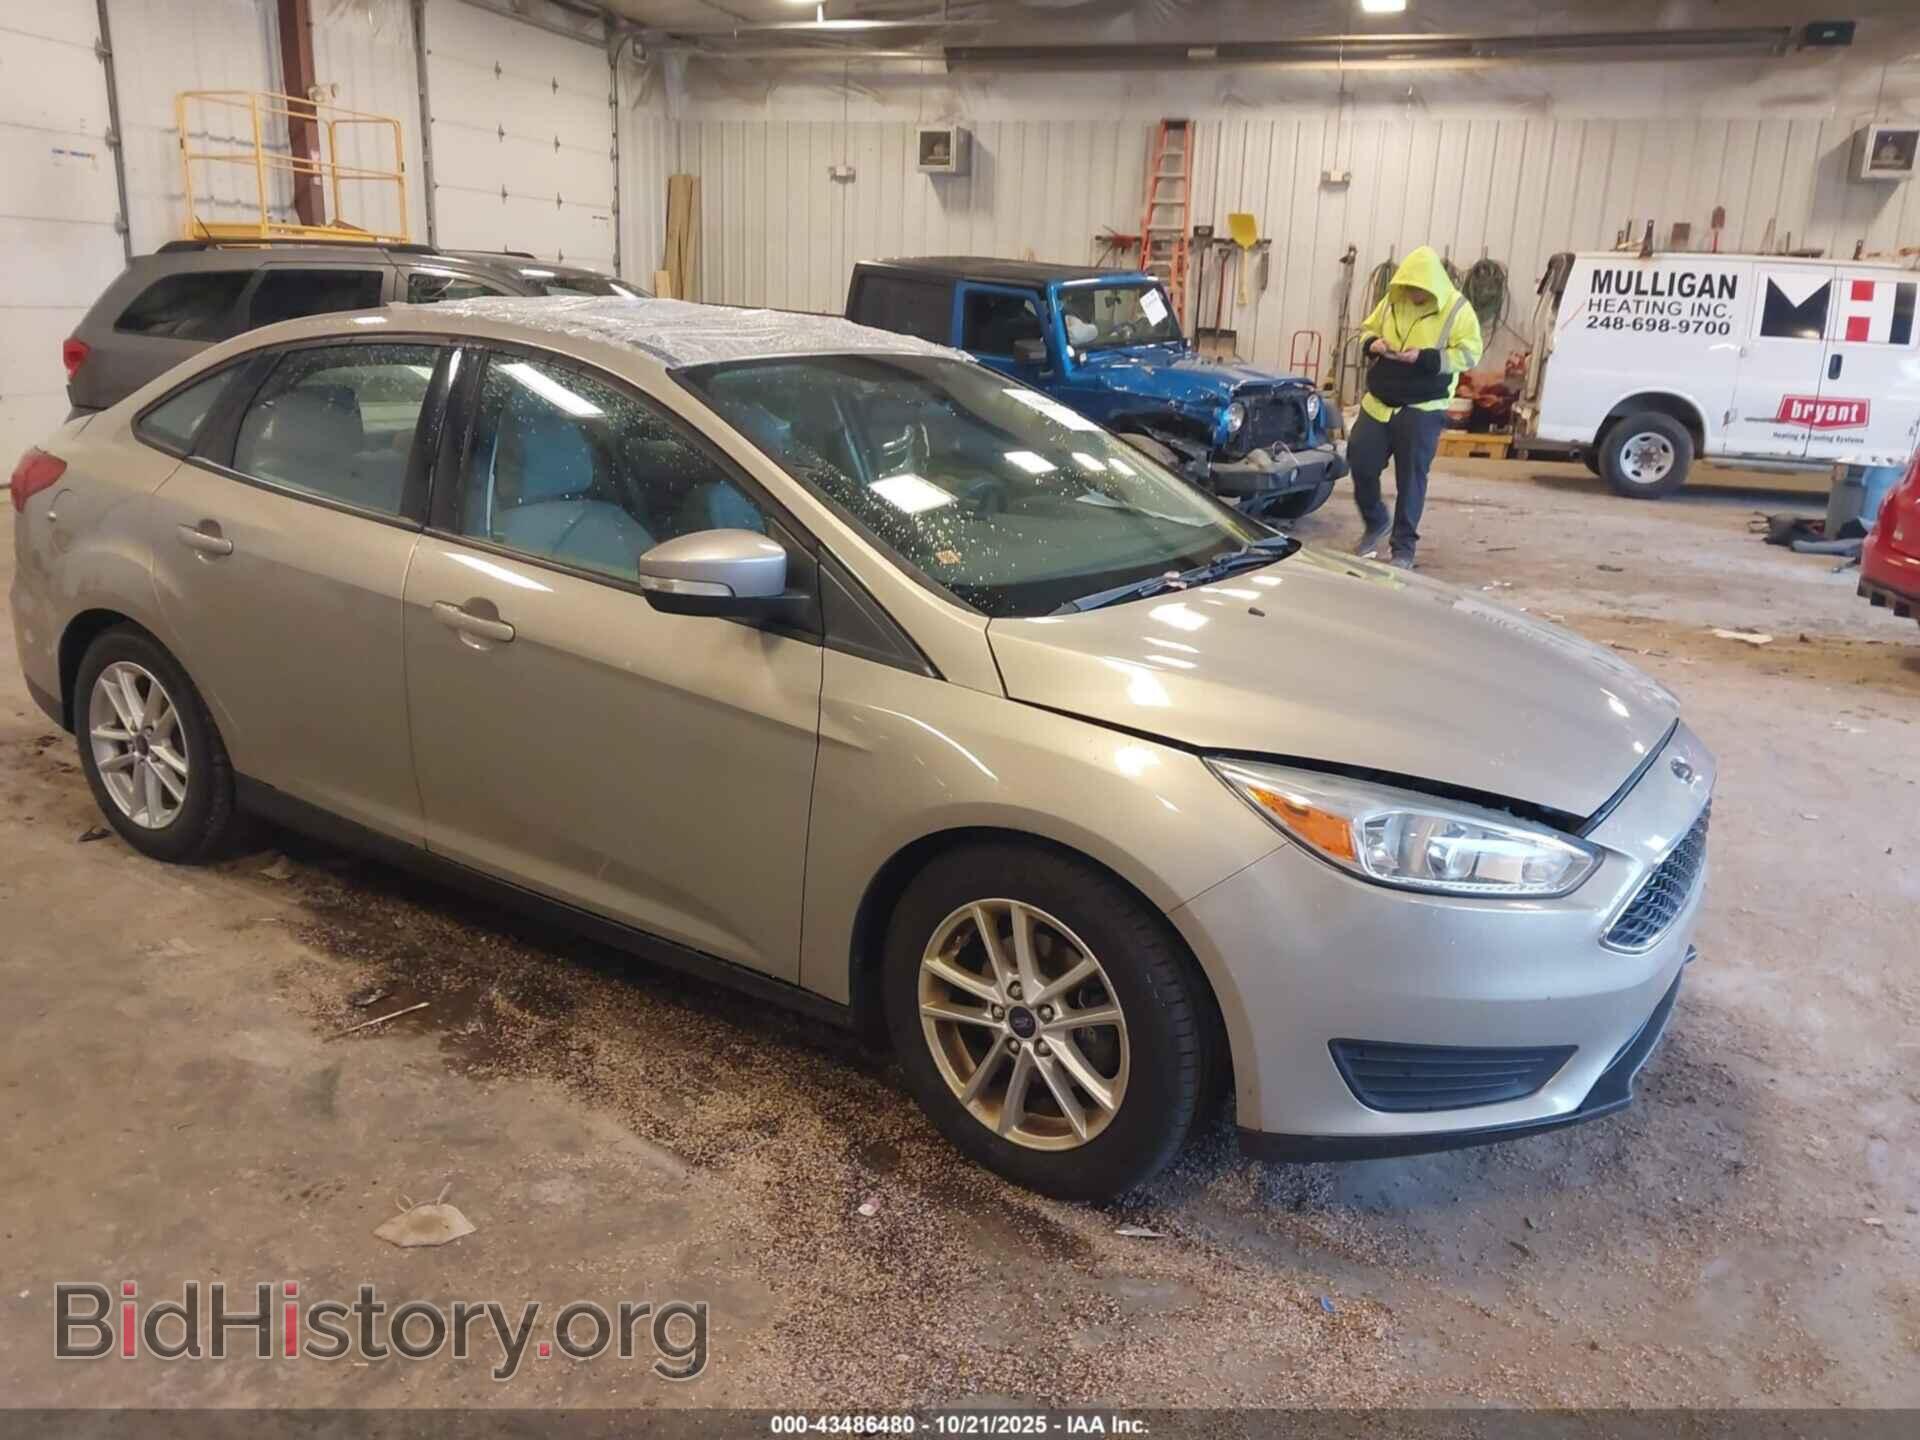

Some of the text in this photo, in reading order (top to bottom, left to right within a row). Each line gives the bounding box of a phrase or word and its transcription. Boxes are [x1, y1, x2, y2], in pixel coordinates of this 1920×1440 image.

[1590, 269, 1738, 300] MULLIGAN
[1588, 298, 1733, 319] HEATING INC.
[1586, 315, 1731, 335] 248-698-9700
[1790, 400, 1859, 423] bryant
